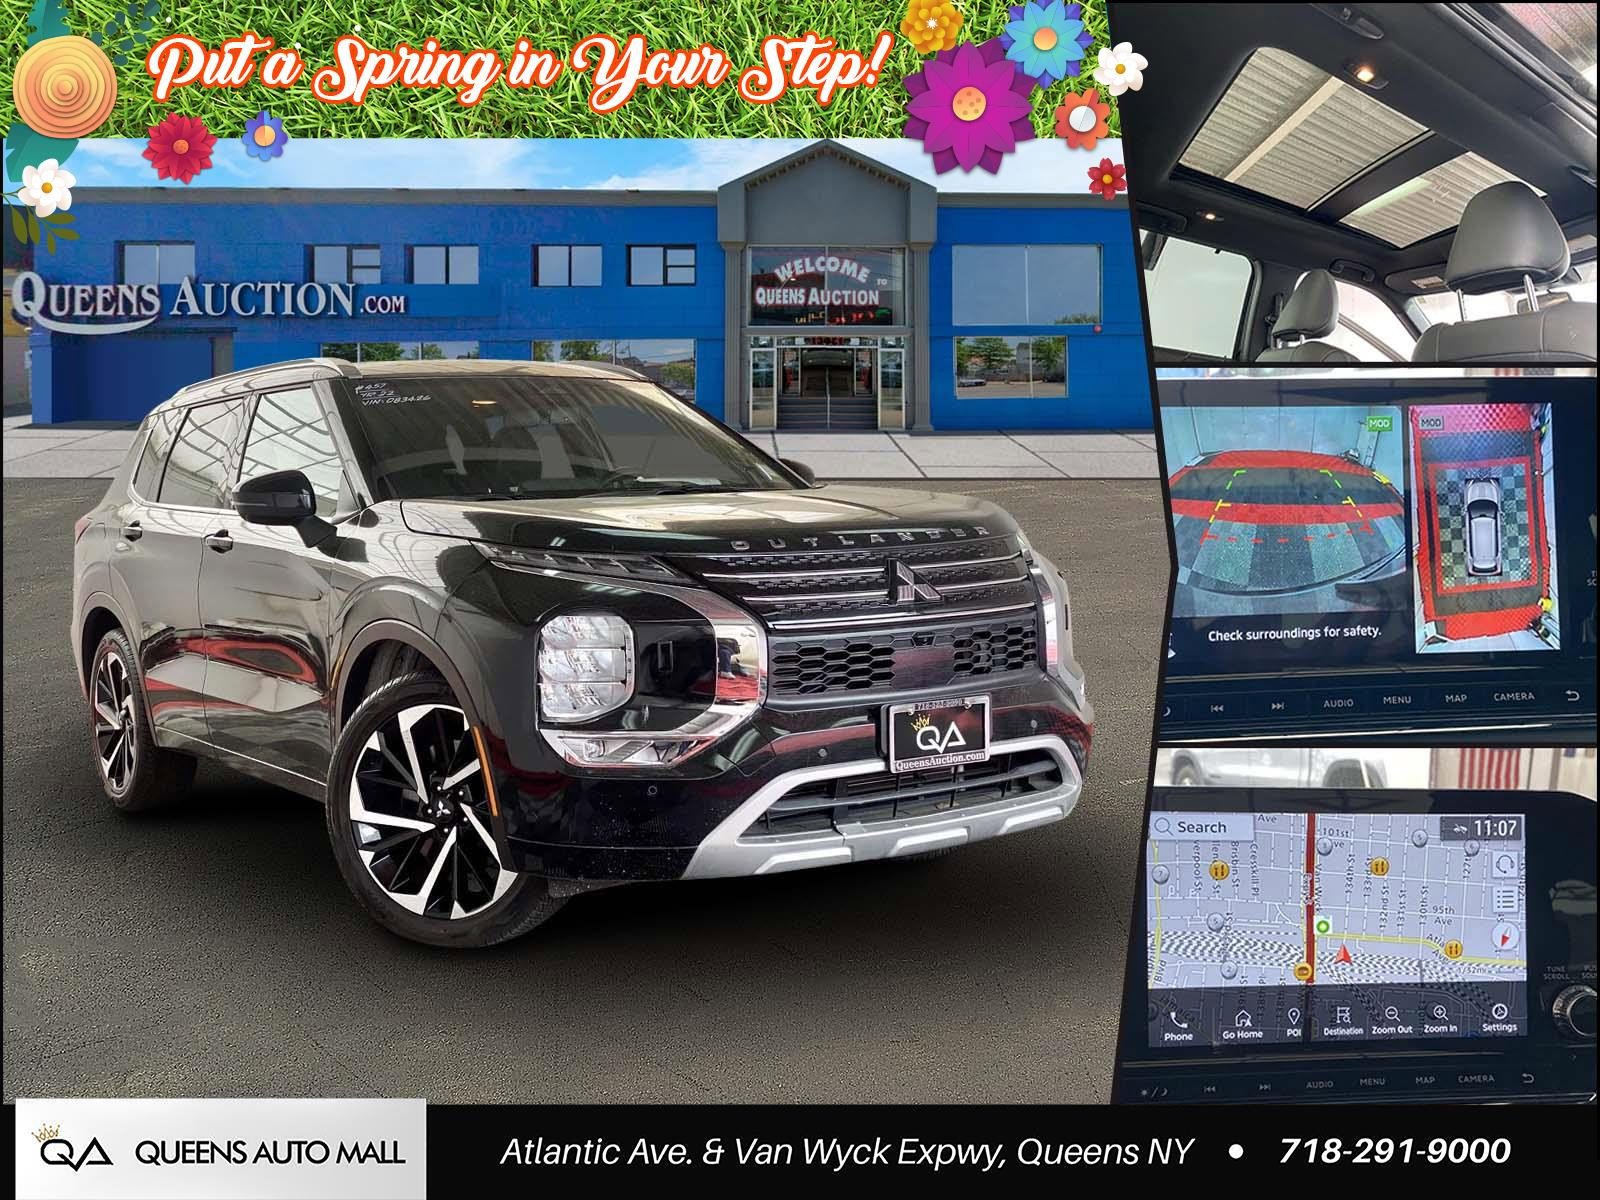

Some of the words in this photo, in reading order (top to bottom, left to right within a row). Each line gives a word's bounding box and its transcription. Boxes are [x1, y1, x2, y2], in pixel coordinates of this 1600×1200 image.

[774, 256, 871, 284] WELCOME
[877, 278, 888, 286] TO
[11, 270, 161, 335] QUEENS
[755, 287, 806, 306] QUEENS
[808, 287, 880, 306] AUCTION
[1369, 419, 1391, 428] MOD
[1421, 418, 1442, 428] MOD
[731, 526, 990, 550] OUTLANDER
[1208, 630, 1243, 642] Check
[1246, 627, 1321, 640] surroundings
[1324, 626, 1340, 638] for
[1343, 625, 1382, 638] safety.
[1323, 698, 1354, 709] AUDIO
[1383, 695, 1412, 706] MENU
[1445, 694, 1468, 703] MAP
[1494, 691, 1536, 702] CAMERA
[916, 721, 967, 753] QA
[895, 752, 986, 771] QueensAuction.com
[1257, 814, 1277, 823] Ave
[1177, 821, 1227, 833] Search
[1323, 828, 1349, 838] 101st
[1475, 819, 1517, 836] 11:07
[1345, 865, 1354, 893] 134th
[1380, 897, 1389, 928] 132nd
[1397, 901, 1406, 927] 131st
[1420, 898, 1428, 925] 130th
[1432, 905, 1455, 915] 95th
[1433, 916, 1453, 925] Ave
[1287, 1029, 1301, 1037] POI
[1323, 1026, 1364, 1036] Destination
[1372, 1026, 1398, 1034] Zoom
[1399, 1025, 1413, 1034] Out
[1424, 1025, 1447, 1033] Zoom
[1450, 1024, 1458, 1032] In
[1482, 1023, 1518, 1033] Settings
[1164, 1032, 1193, 1041] Phone
[1222, 1031, 1235, 1040] Go
[1237, 1030, 1264, 1039] Home
[1306, 1079, 1334, 1089] AUDIO
[1359, 1077, 1385, 1086] MENU
[1416, 1076, 1435, 1085] MAP
[1458, 1074, 1495, 1083] CAMERA
